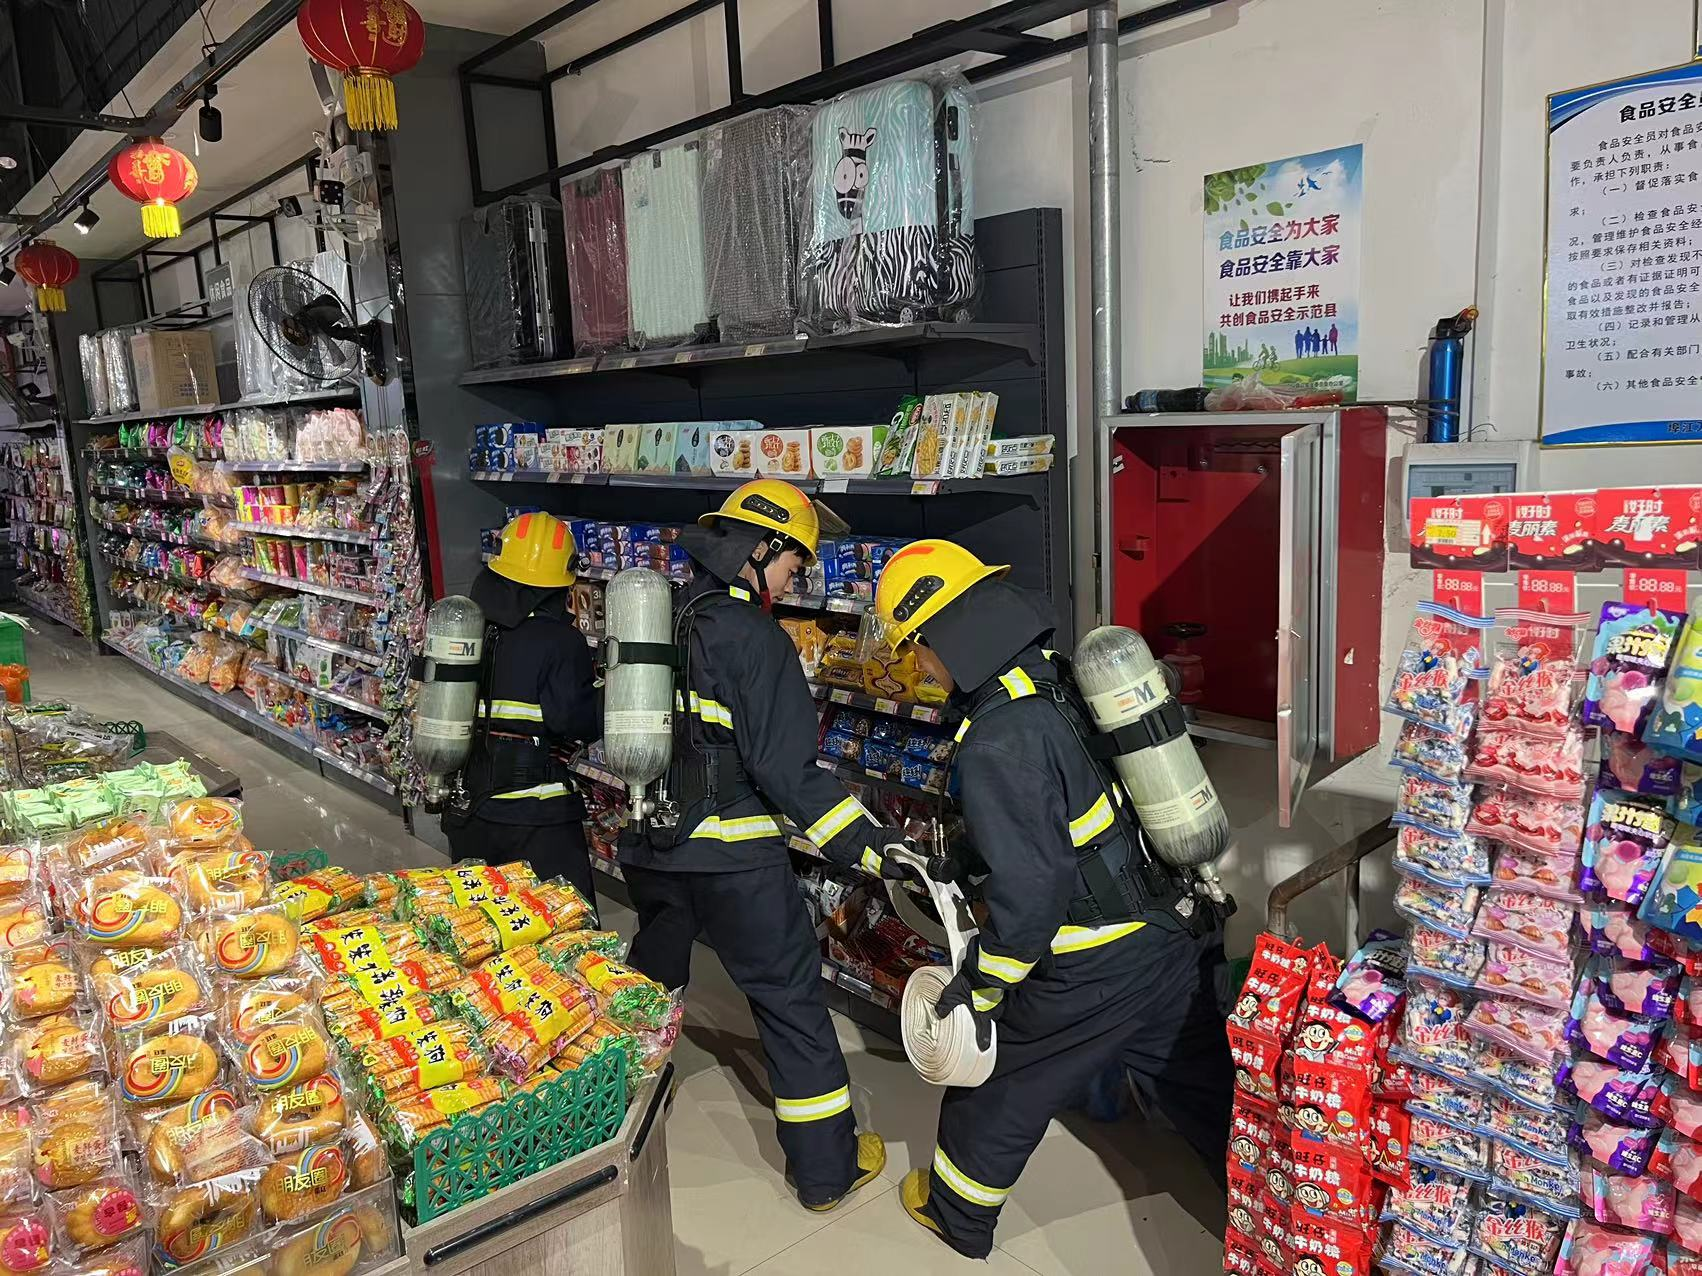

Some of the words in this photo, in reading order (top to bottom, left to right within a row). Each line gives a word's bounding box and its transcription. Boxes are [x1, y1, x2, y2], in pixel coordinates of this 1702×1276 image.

[1619, 91, 1702, 123] 食品安全
[1218, 213, 1341, 251] 食品安全为大家
[1219, 244, 1341, 280] 食品安全靠大家
[1228, 284, 1320, 307] 让我们携起手来
[1219, 303, 1337, 328] 共创食品安全示范县
[1400, 667, 1449, 690] 金丝猴
[1502, 670, 1554, 696] 金丝猴
[111, 949, 148, 969] 朋友
[267, 1028, 318, 1057] 朋友圈
[1438, 1049, 1470, 1065] Monke
[271, 1089, 323, 1113] 朋友圈
[1295, 1086, 1342, 1109] 牛奶糖
[1520, 1119, 1550, 1136] Monke
[1296, 1152, 1326, 1166] 旺仔
[1443, 1144, 1470, 1159] Monke
[276, 1166, 328, 1194] 朋友圈
[1295, 1163, 1341, 1187] 牛奶糖
[1486, 1214, 1547, 1244] 金丝猴
[1295, 1235, 1341, 1260] 牛奶糖
[1420, 1250, 1447, 1269] Monke
[1508, 1246, 1537, 1263] Monke
